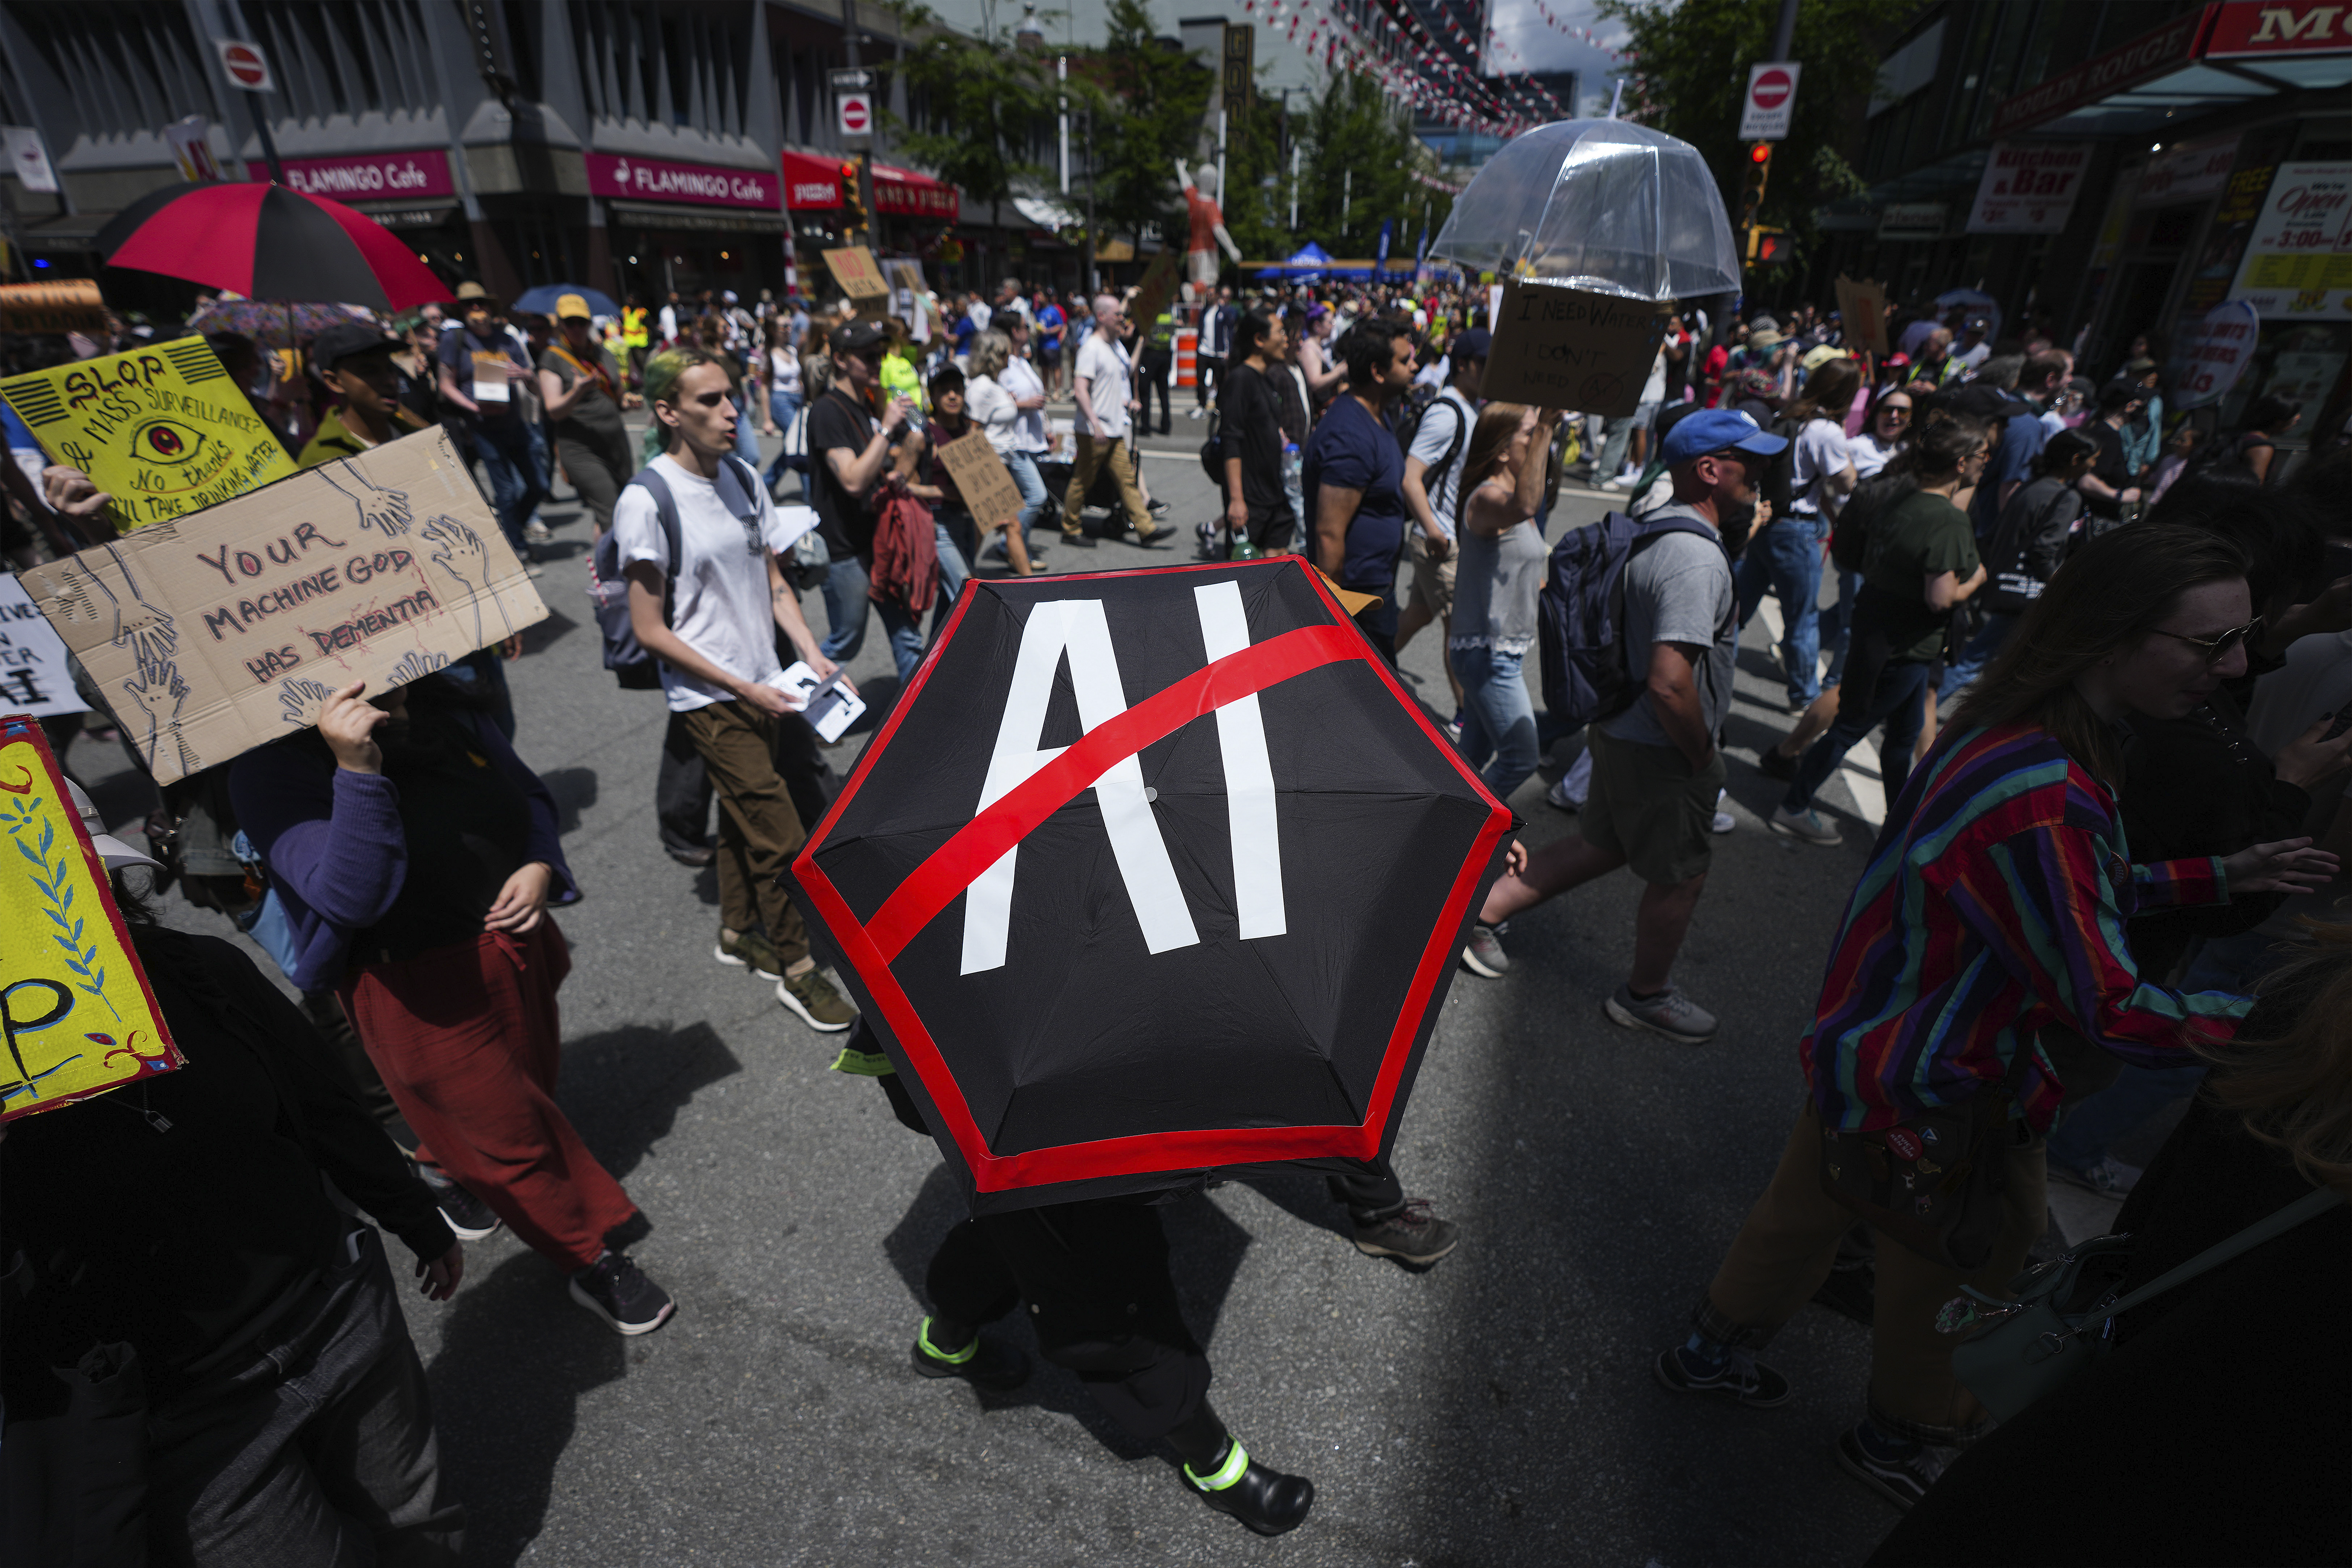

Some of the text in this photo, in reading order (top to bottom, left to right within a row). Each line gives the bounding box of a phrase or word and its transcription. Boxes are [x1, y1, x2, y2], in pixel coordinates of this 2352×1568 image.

[2249, 6, 2352, 44] M
[2085, 26, 2188, 88] ROUGE
[1996, 150, 2083, 167] Kitchen
[286, 160, 428, 194] FLAMINGO Cafe
[634, 166, 765, 202] FLAMINGO Cafe
[2010, 169, 2075, 196] Bar
[2226, 165, 2274, 194] FREE
[2277, 186, 2347, 218] Open
[834, 250, 865, 278] NO
[1518, 294, 1538, 321] I
[1541, 298, 1587, 322] NEED
[1538, 342, 1607, 367] DON'T
[64, 356, 167, 411] SLOP
[1523, 370, 1569, 389] NEED
[83, 390, 142, 445] MASS
[144, 388, 262, 435] SURVEILLANCE?
[143, 495, 187, 519] TAKE
[191, 466, 248, 509] DRINKING
[243, 439, 278, 475] WATER
[197, 522, 348, 586] YOUR
[202, 546, 415, 643] MACHINE GOD
[244, 590, 439, 684] HAS DEMENTIA
[0, 646, 44, 666] ER
[960, 580, 1287, 976] AI
[1897, 1134, 1915, 1151] EVICT
